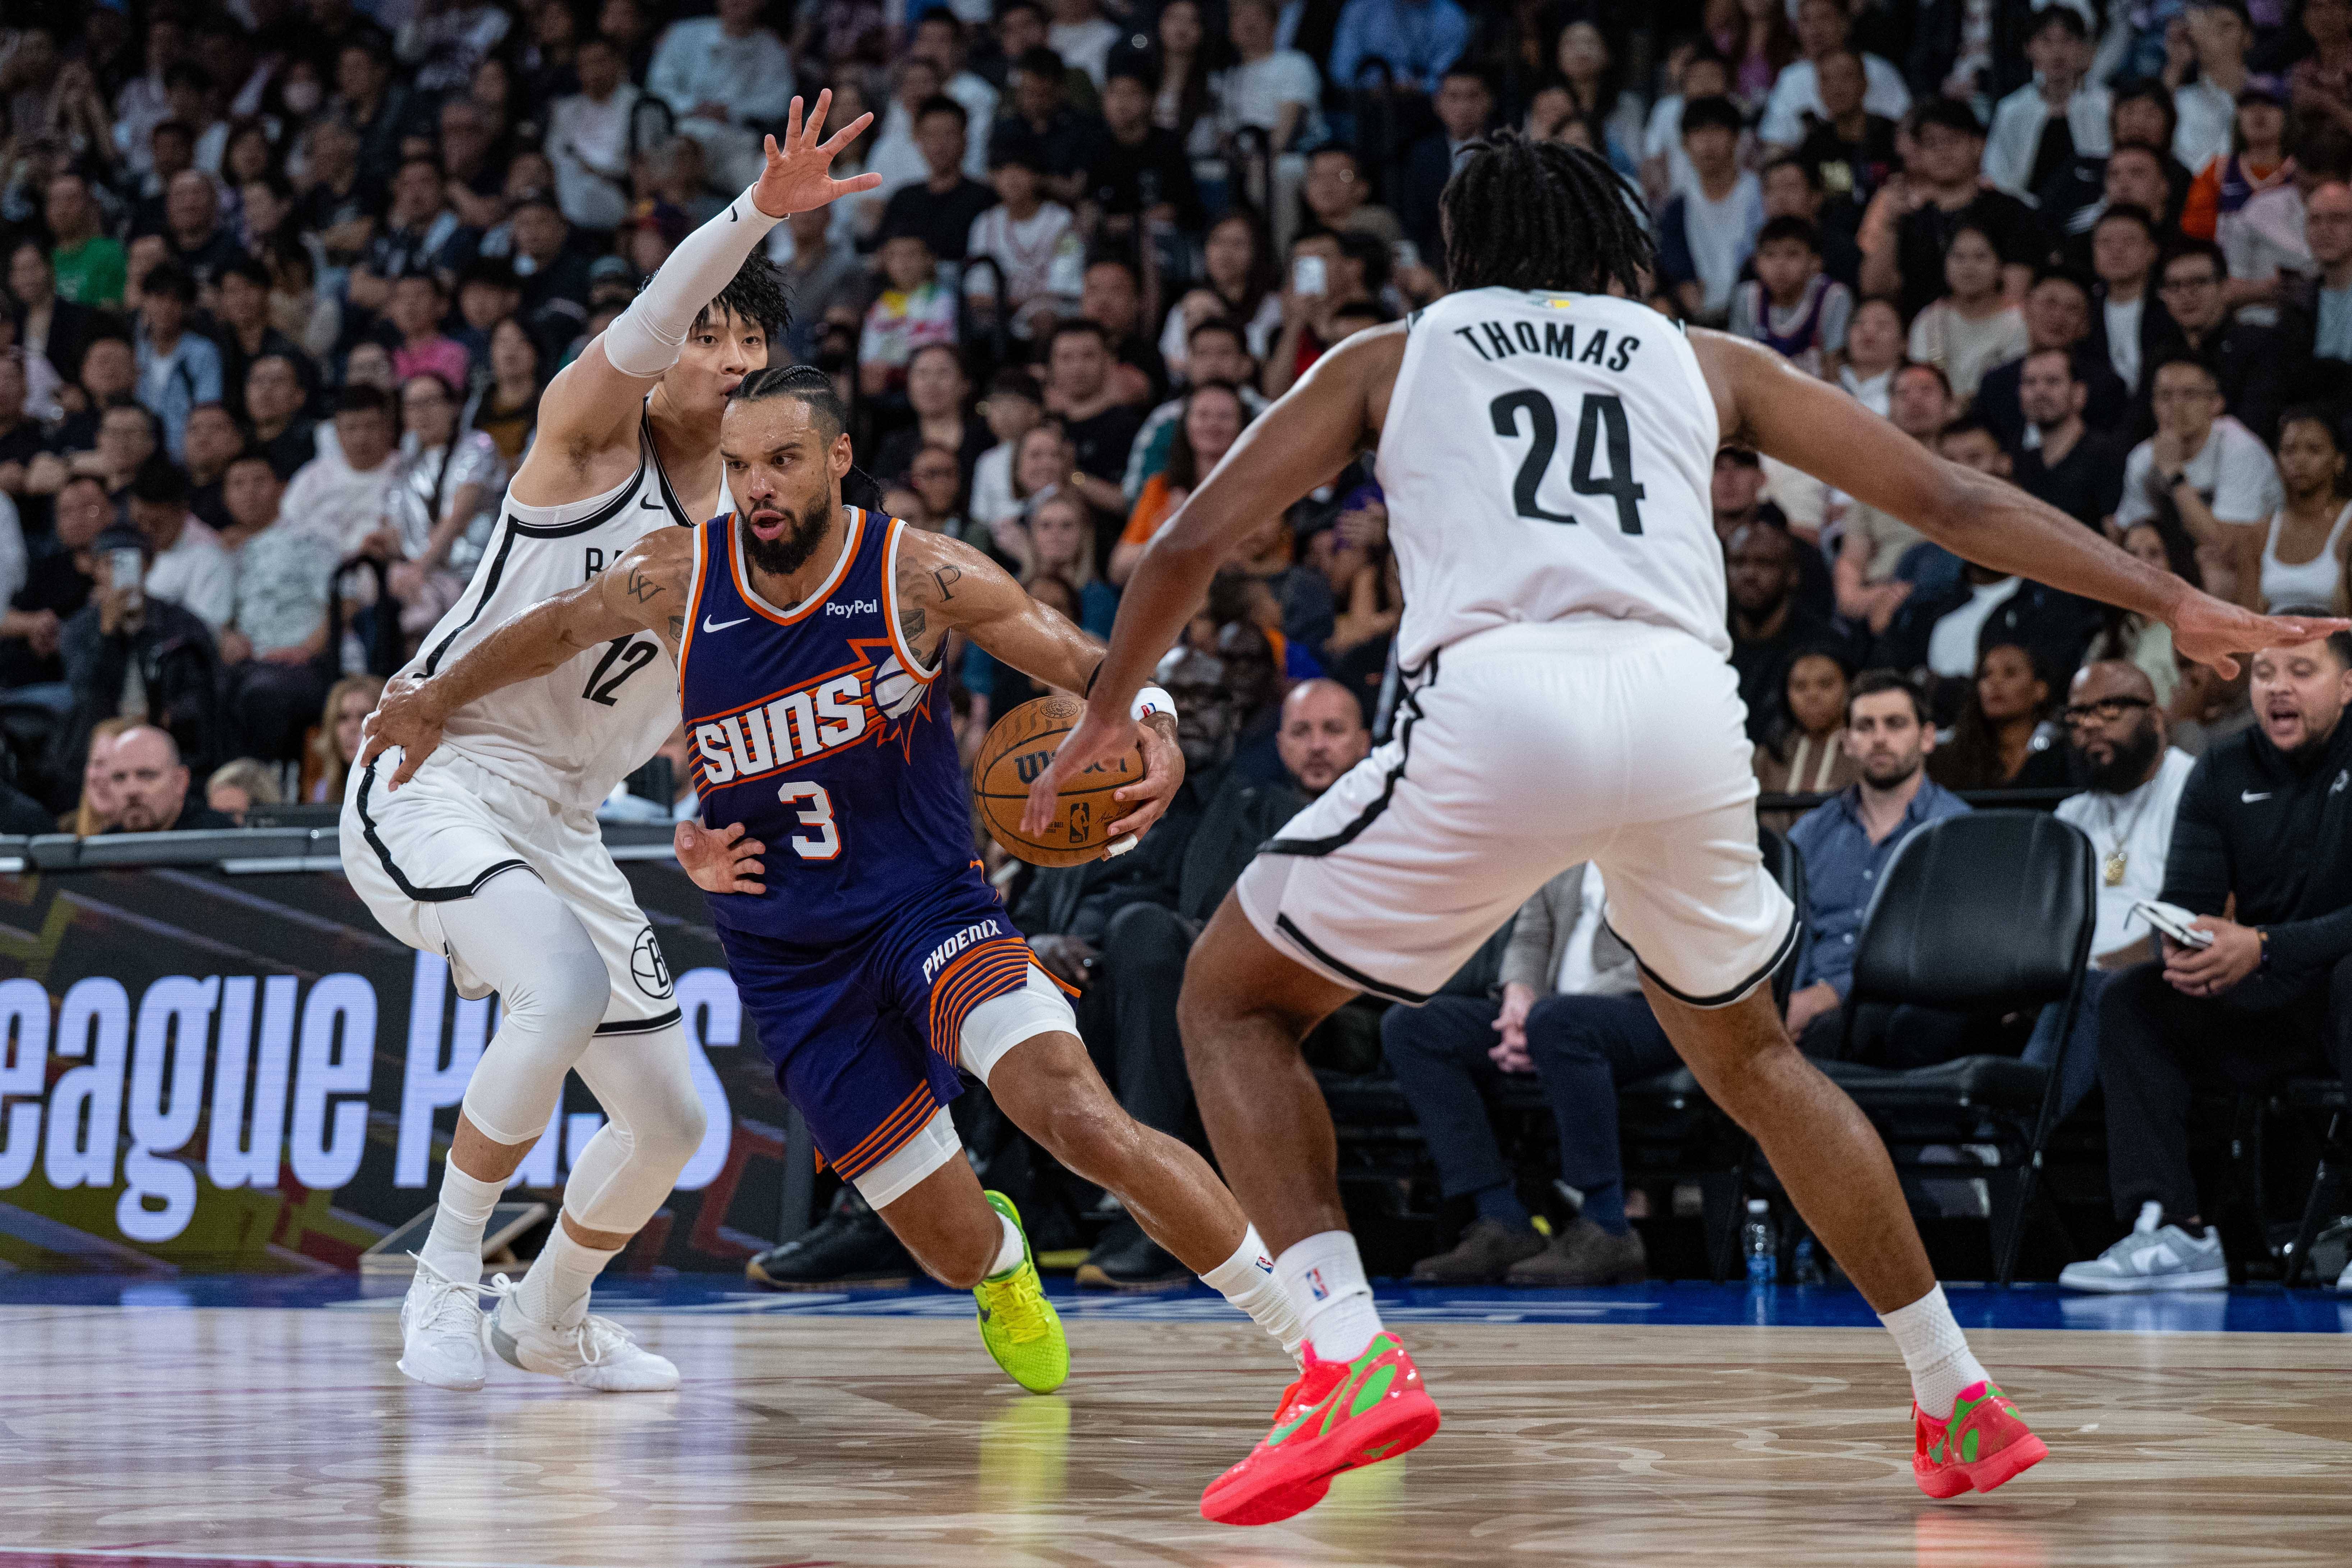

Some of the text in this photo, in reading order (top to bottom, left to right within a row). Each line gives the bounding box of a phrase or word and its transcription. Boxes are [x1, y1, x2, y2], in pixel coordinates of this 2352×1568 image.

[1454, 320, 1640, 372] THOMAS
[1489, 389, 1645, 536] 24
[826, 599, 877, 618] PayPal
[582, 634, 658, 706] 12
[778, 781, 841, 860] 3
[922, 920, 1003, 985] PHOENIX
